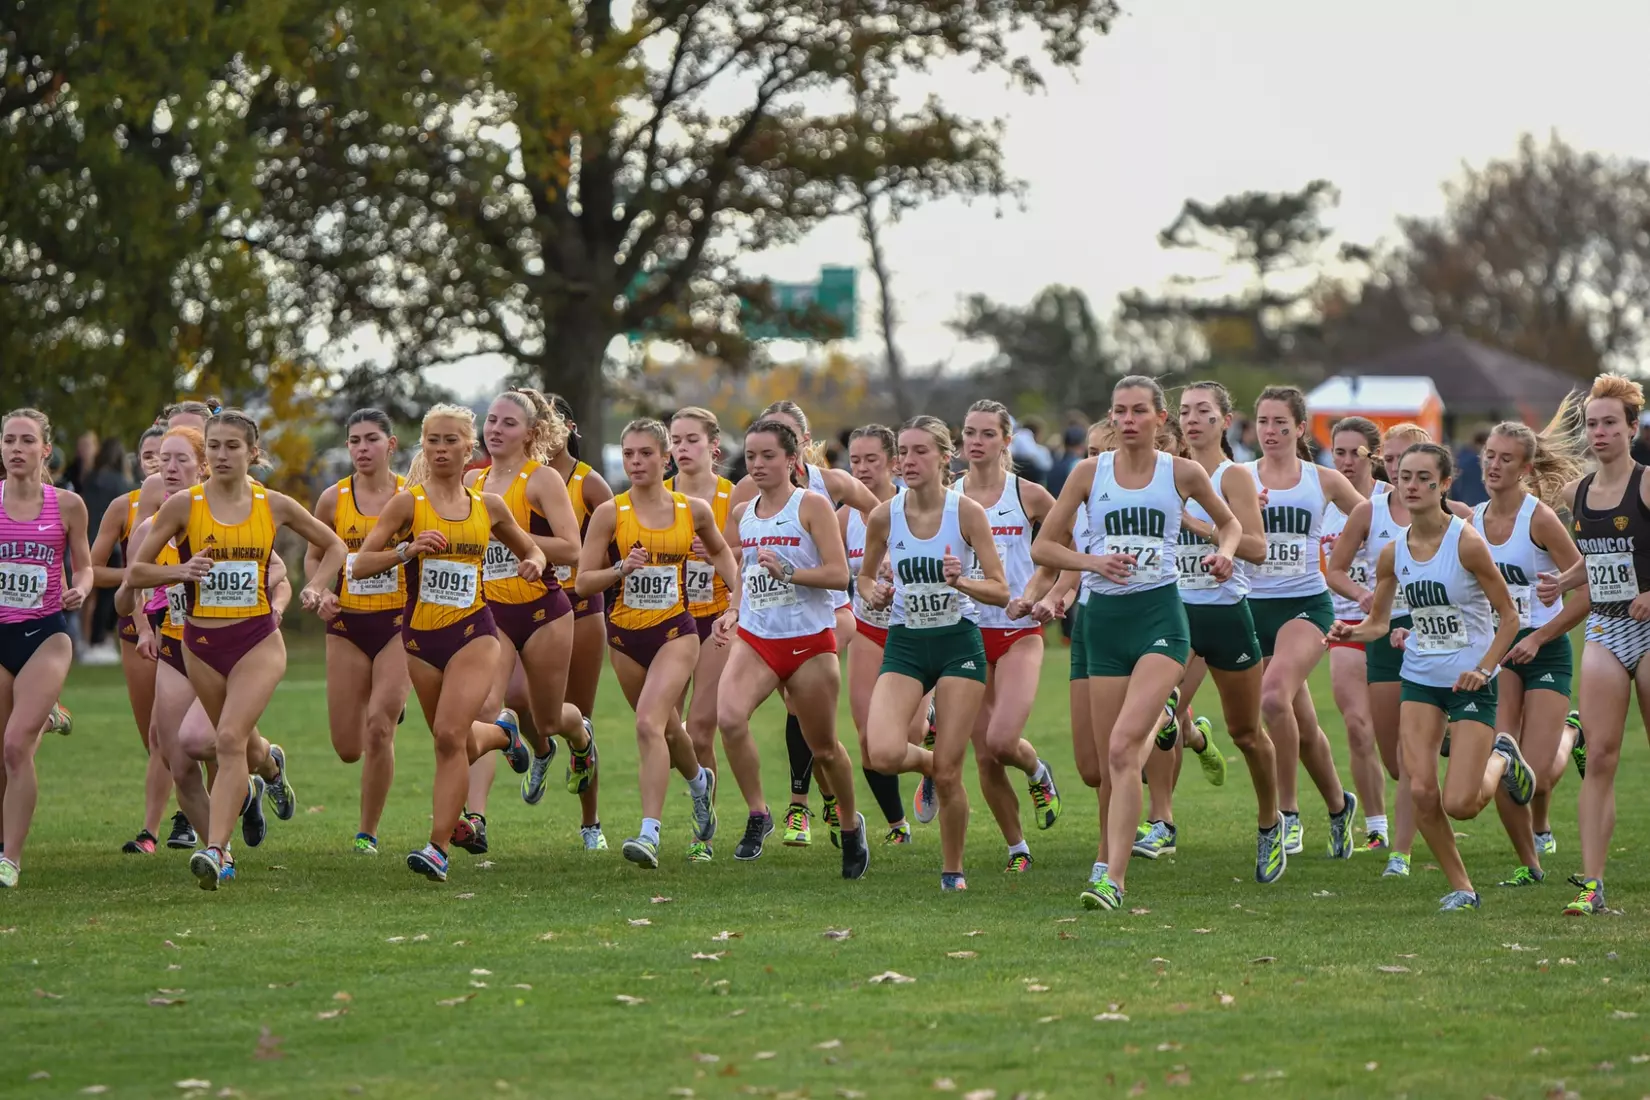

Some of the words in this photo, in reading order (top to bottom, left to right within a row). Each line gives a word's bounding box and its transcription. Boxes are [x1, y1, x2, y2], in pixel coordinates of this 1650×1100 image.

[990, 526, 1024, 536] TATE
[1105, 506, 1166, 538] OHIO
[1262, 506, 1312, 536] HIO
[741, 537, 758, 549] ALL
[760, 535, 801, 547] STATE
[0, 541, 56, 566] OLEDO
[232, 546, 265, 560] MICHIGAN
[482, 546, 514, 565] 082
[1269, 543, 1300, 562] 169
[206, 571, 253, 591] 3092
[428, 569, 469, 592] 3091
[687, 570, 709, 589] 79
[898, 556, 947, 586] OHIO
[1348, 566, 1366, 583] 23
[1495, 562, 1529, 587] IO
[1590, 563, 1630, 585] 3218
[0, 571, 39, 594] 3191
[630, 575, 672, 595] 3097
[171, 593, 188, 611] 30
[909, 593, 951, 613] 3167
[1405, 580, 1451, 608] OHIO
[1418, 615, 1459, 635] 3166
